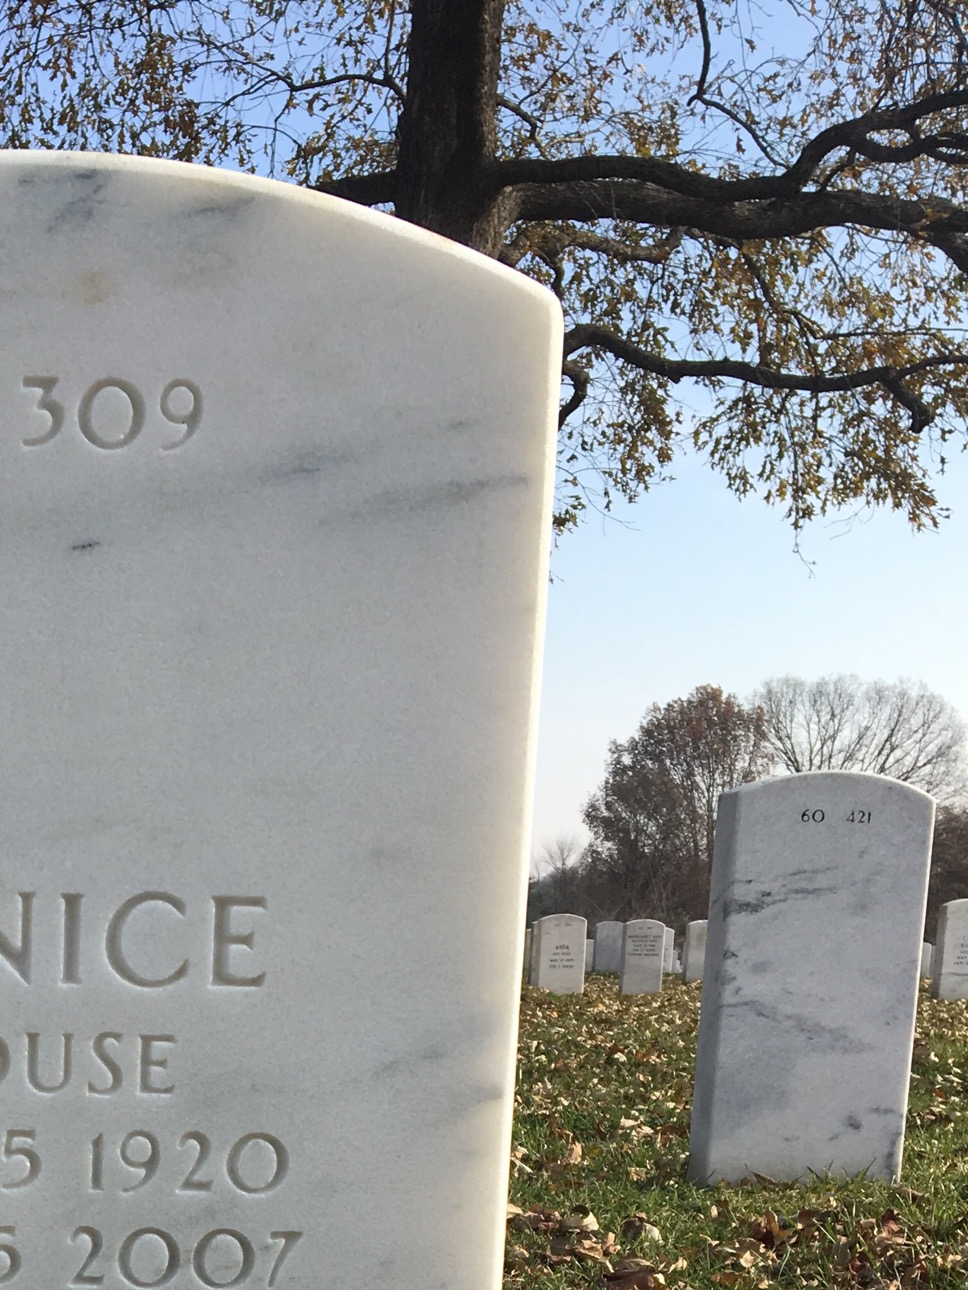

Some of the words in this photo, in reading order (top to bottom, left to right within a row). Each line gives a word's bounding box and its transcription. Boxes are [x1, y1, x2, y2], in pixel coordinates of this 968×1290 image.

[22, 375, 204, 451] 309
[801, 808, 825, 823] 60
[846, 810, 871, 824] 421
[90, 1130, 290, 1195] 1920
[68, 1225, 303, 1290] 2007
